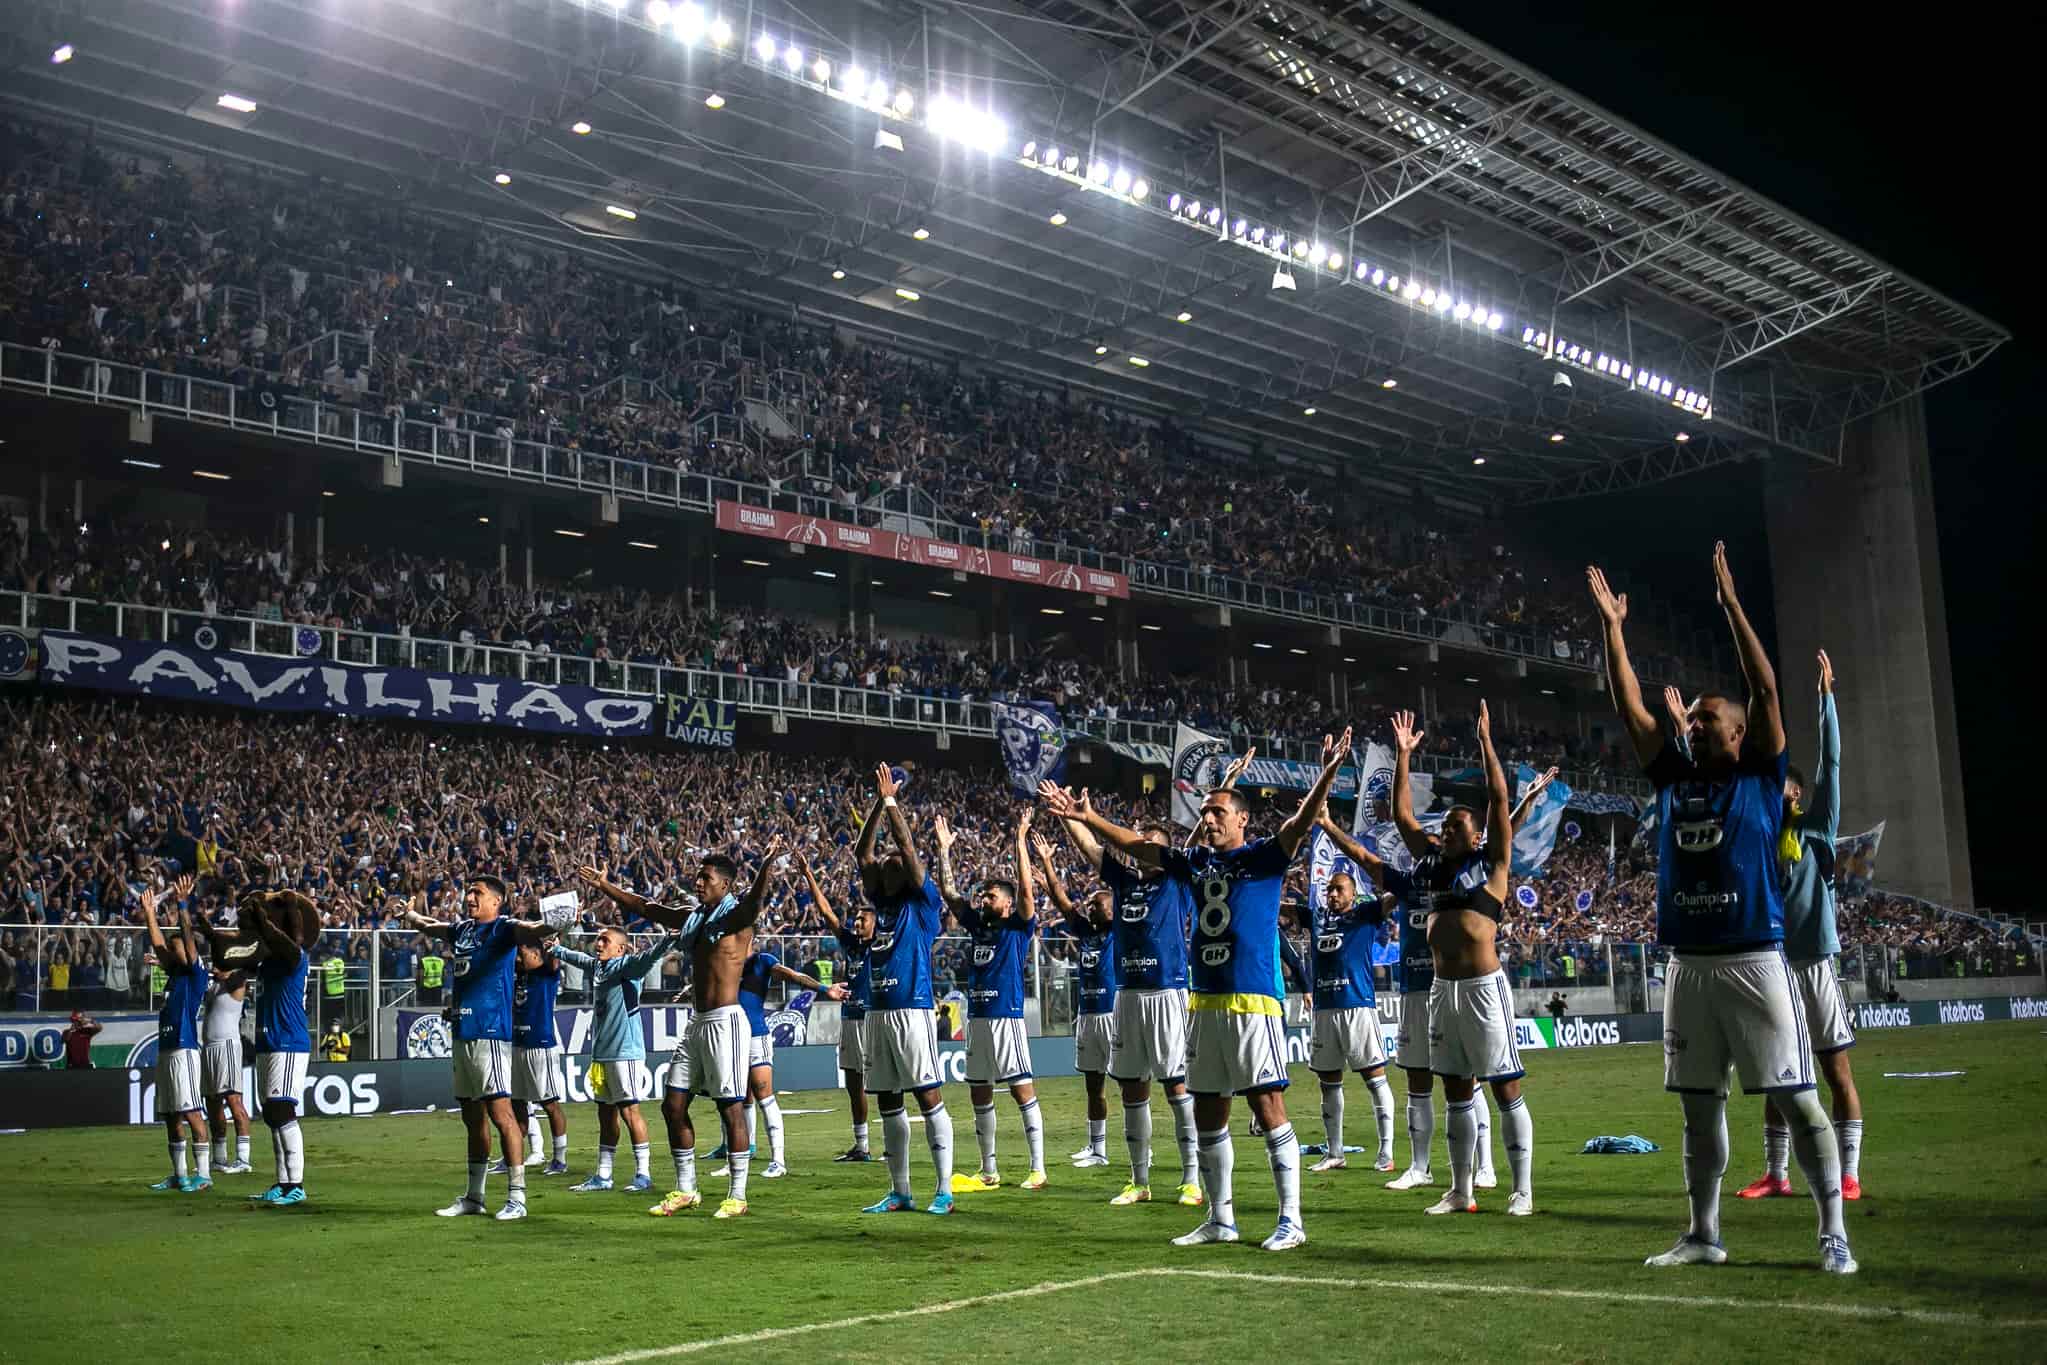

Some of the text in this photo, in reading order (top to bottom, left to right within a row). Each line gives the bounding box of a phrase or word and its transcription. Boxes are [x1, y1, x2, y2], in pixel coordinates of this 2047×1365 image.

[741, 509, 775, 527] BRAHMA
[838, 527, 870, 544] BRAHMA
[928, 543, 958, 560] BRAHMA
[1012, 559, 1041, 575] BRAHMA
[42, 635, 653, 731] PAVILHÃO
[667, 692, 736, 730] FAL
[666, 721, 734, 746] LAVRAS
[1200, 877, 1231, 936] 8
[1673, 890, 1738, 911] Champion
[1858, 1003, 1911, 1028] intelbras
[1938, 998, 1985, 1024] intelbras
